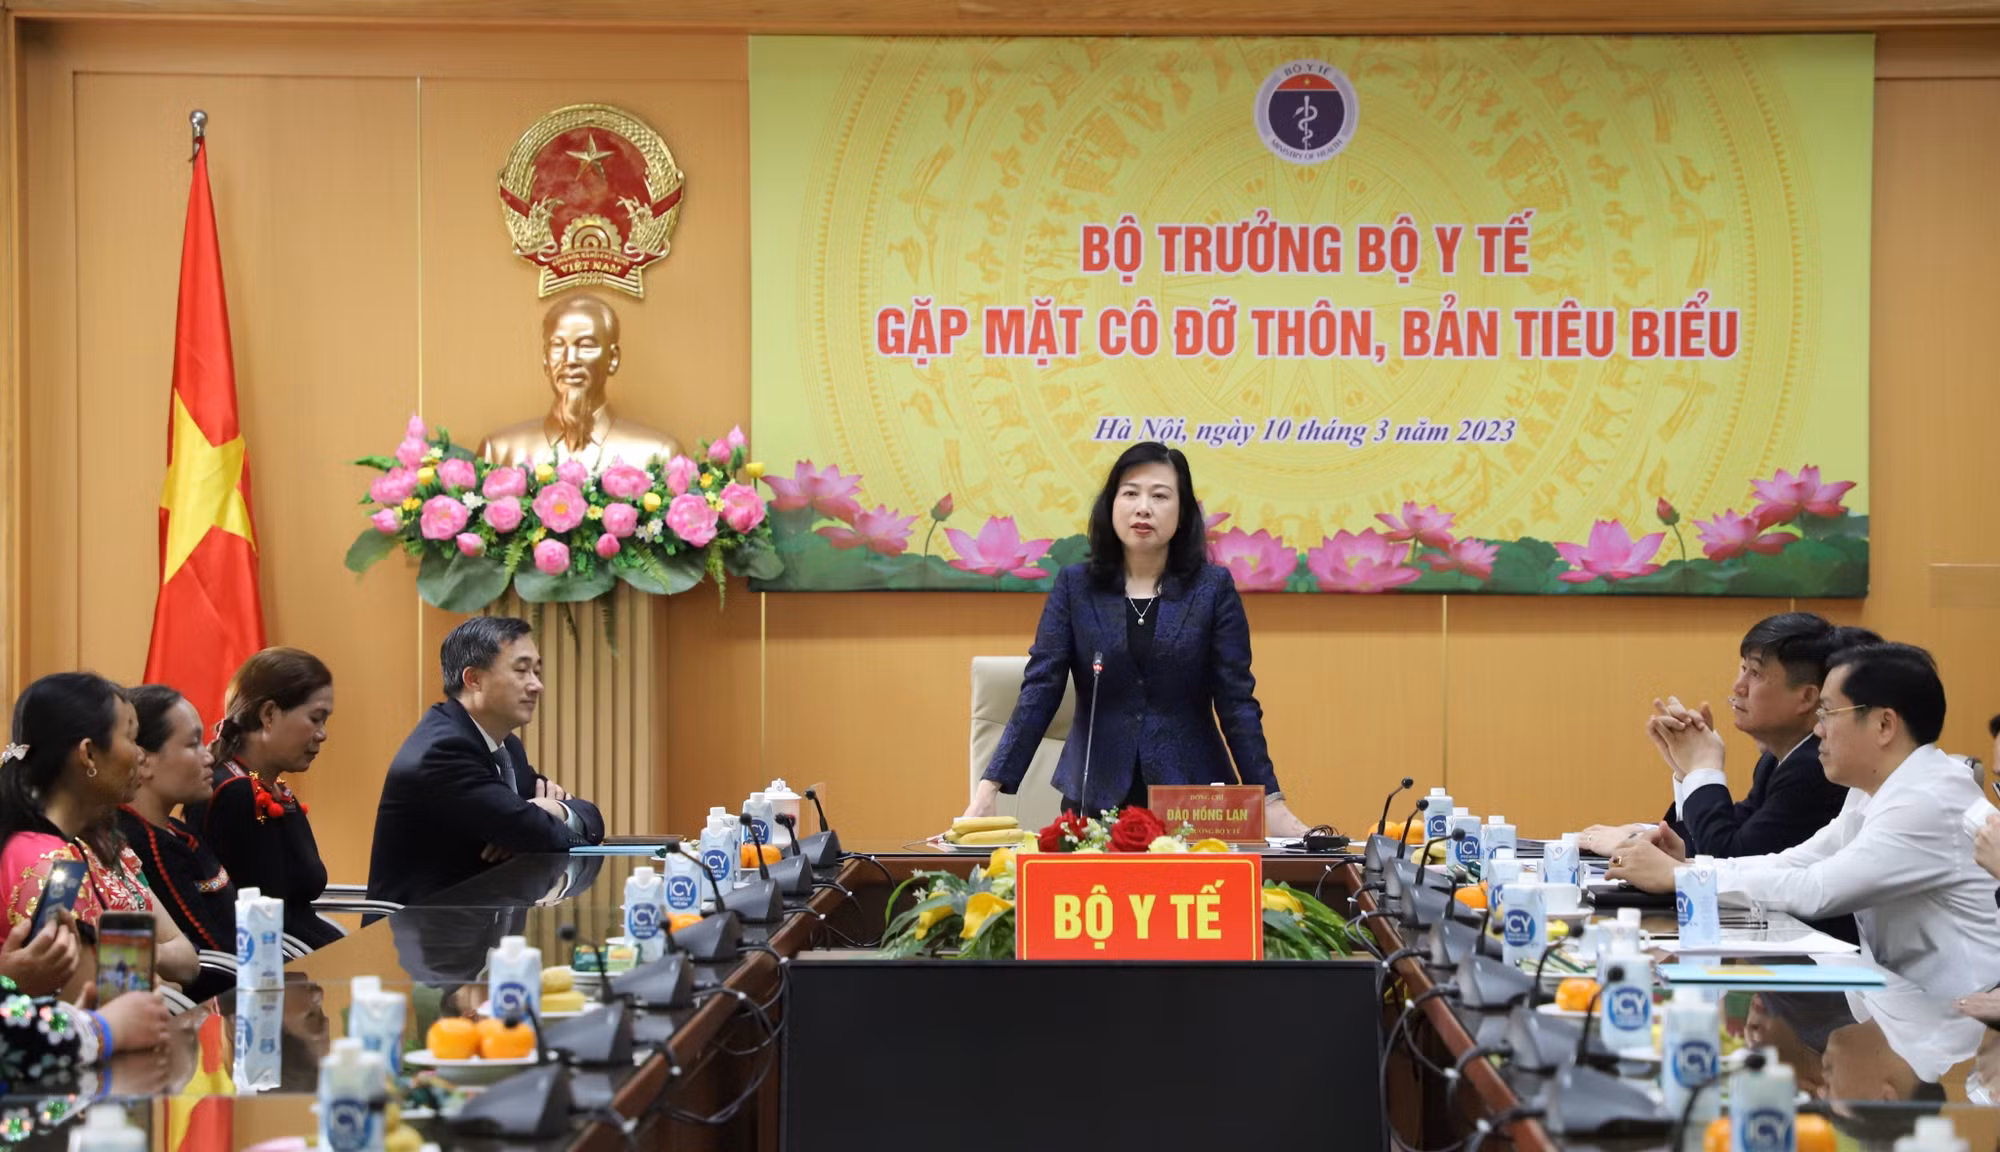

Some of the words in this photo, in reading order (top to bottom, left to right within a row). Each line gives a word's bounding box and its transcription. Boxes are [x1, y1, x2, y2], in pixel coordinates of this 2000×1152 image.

[1082, 214, 1142, 283] BỘ
[1157, 209, 1341, 273] TRƯỞNG
[1358, 216, 1419, 284] BỘ
[1435, 226, 1463, 273] Y
[1476, 210, 1534, 273] TẾ
[592, 261, 622, 273] NAM
[877, 298, 969, 365] GẶP
[985, 298, 1083, 366] MẶT
[1099, 299, 1159, 356] CÔ
[1173, 299, 1238, 357] ĐỠ
[1251, 300, 1385, 363] THÔN,
[1402, 294, 1499, 357] BẢN
[1514, 300, 1615, 358] TIÊU
[1631, 291, 1739, 359] BIỂU
[1095, 418, 1131, 440] Hà
[1138, 418, 1188, 446] Nội,
[1196, 418, 1255, 447] ngày
[1263, 418, 1293, 441] 10
[1298, 419, 1367, 447] tháng
[1373, 419, 1389, 441] 3
[1395, 419, 1449, 441] năm
[1456, 419, 1516, 442] 2023
[1167, 806, 1190, 821] ĐÀO
[1226, 808, 1248, 821] LAN
[1459, 840, 1479, 855] ICY
[704, 855, 727, 869] ICY
[669, 881, 694, 896] ICY
[631, 908, 657, 925] ICY
[1054, 884, 1114, 950] BỘ
[1128, 894, 1157, 940] Y
[1169, 879, 1225, 940] TẾ
[1505, 915, 1532, 932] ICY
